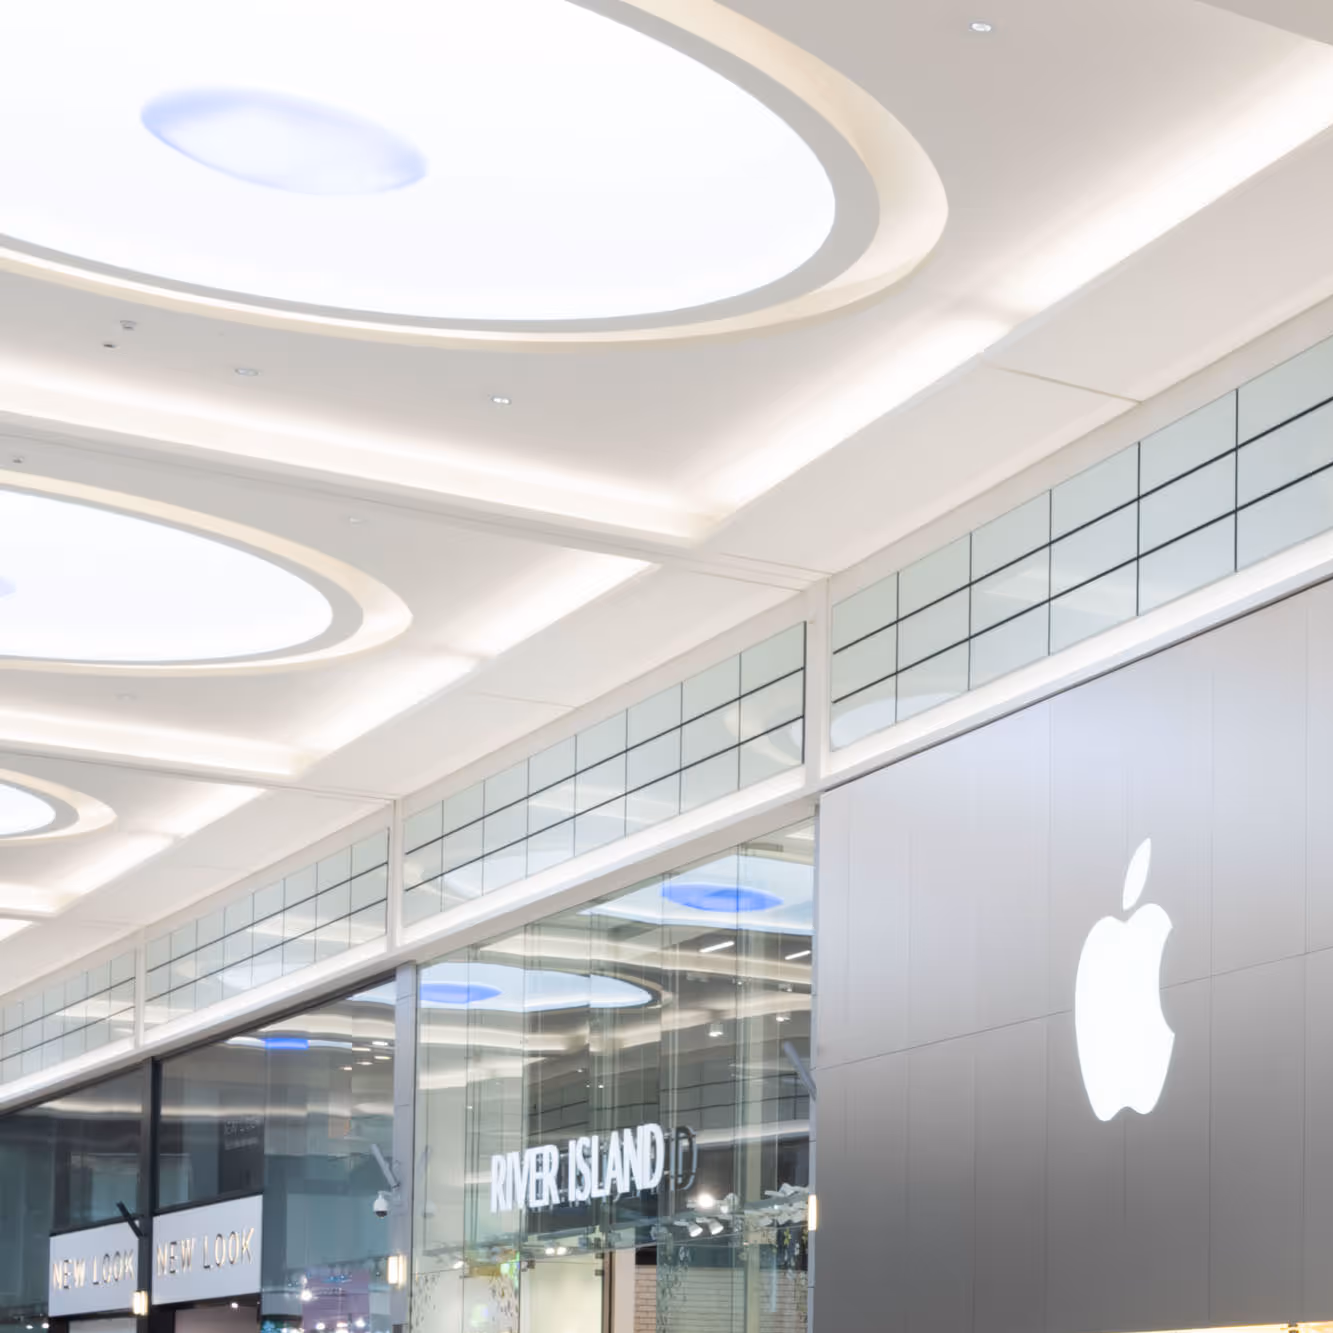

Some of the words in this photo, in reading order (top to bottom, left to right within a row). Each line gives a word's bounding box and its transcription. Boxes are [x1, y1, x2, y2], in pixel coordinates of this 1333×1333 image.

[491, 1144, 560, 1213] RIVER
[568, 1122, 664, 1202] ISLAND
[53, 1258, 86, 1290] NEW
[92, 1249, 135, 1286] LOOK
[157, 1238, 197, 1276] NEW
[203, 1227, 254, 1270] LOOK
